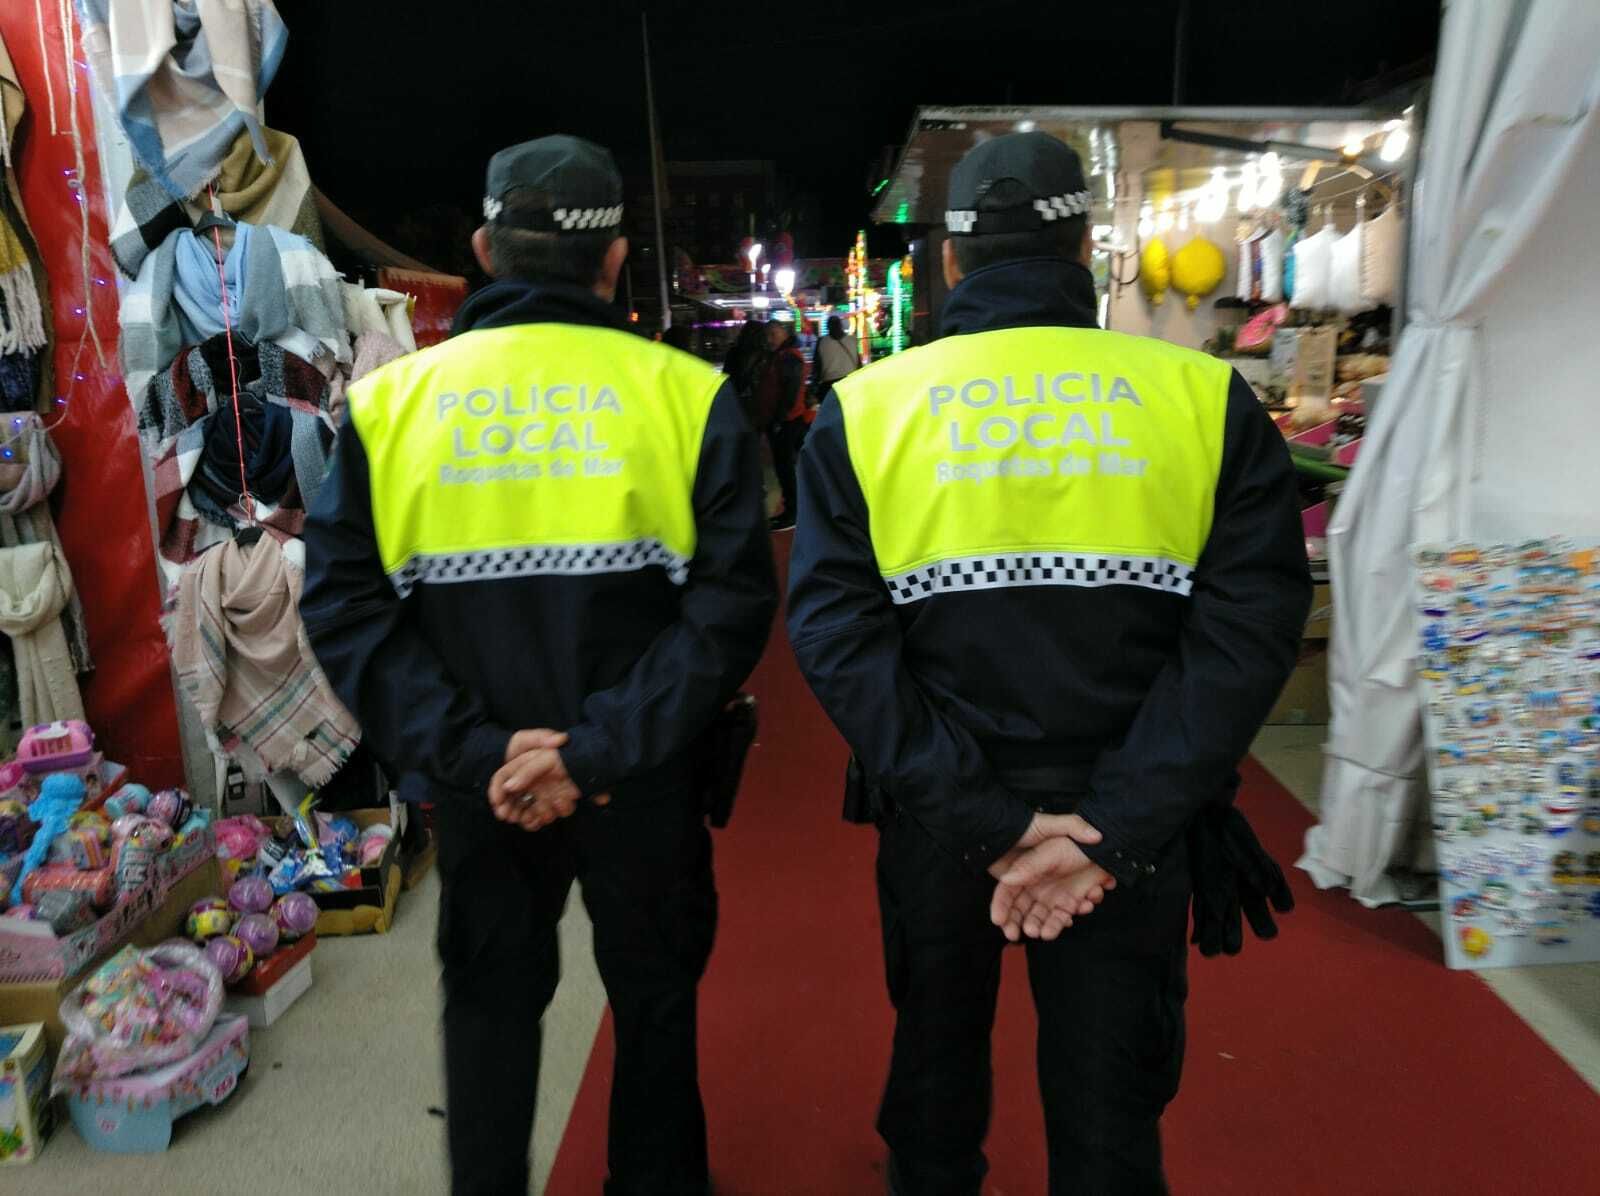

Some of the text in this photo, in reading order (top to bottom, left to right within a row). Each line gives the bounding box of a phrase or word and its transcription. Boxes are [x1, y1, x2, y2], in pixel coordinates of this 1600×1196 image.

[438, 384, 622, 421] POLICIA
[929, 372, 1142, 416] POLICIA
[453, 421, 608, 458] LOCAL
[951, 411, 1131, 452] LOCAL
[936, 452, 1147, 485] Roquetas de Mar
